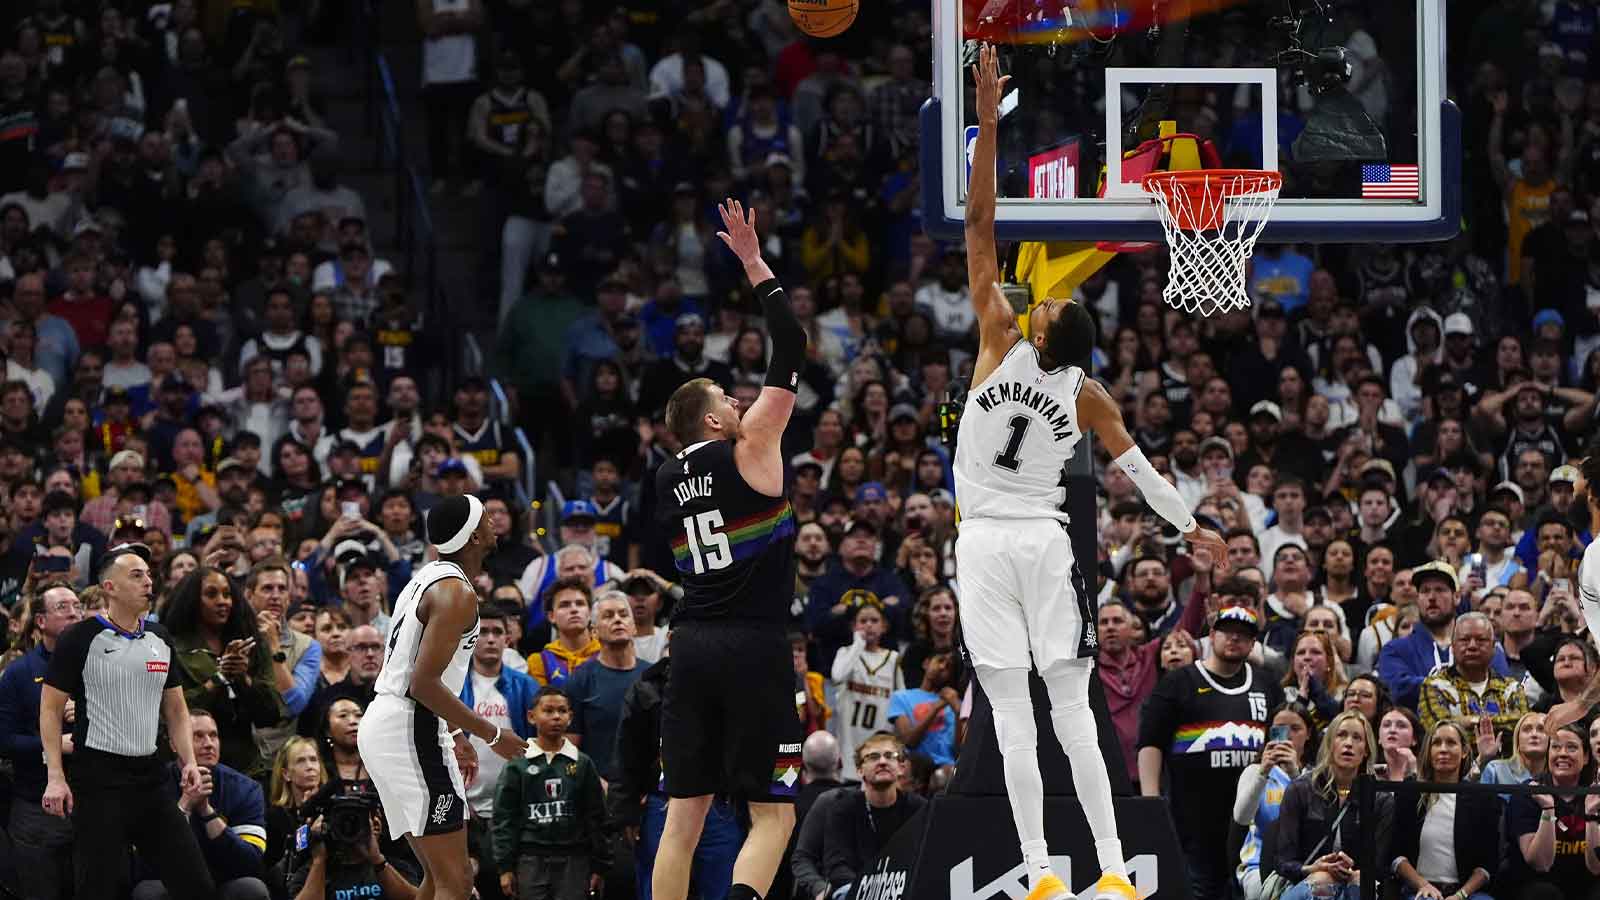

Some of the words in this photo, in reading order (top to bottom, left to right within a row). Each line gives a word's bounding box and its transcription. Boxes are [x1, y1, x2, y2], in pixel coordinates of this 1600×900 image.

[976, 382, 1072, 442] WEMBANYAMA
[992, 413, 1032, 474] 1
[674, 472, 713, 506] JOKIĆ
[683, 509, 733, 575] 15
[851, 701, 877, 729] 10
[1249, 698, 1267, 721] 15
[1211, 751, 1257, 768] DENVE
[856, 856, 906, 900] coinbase
